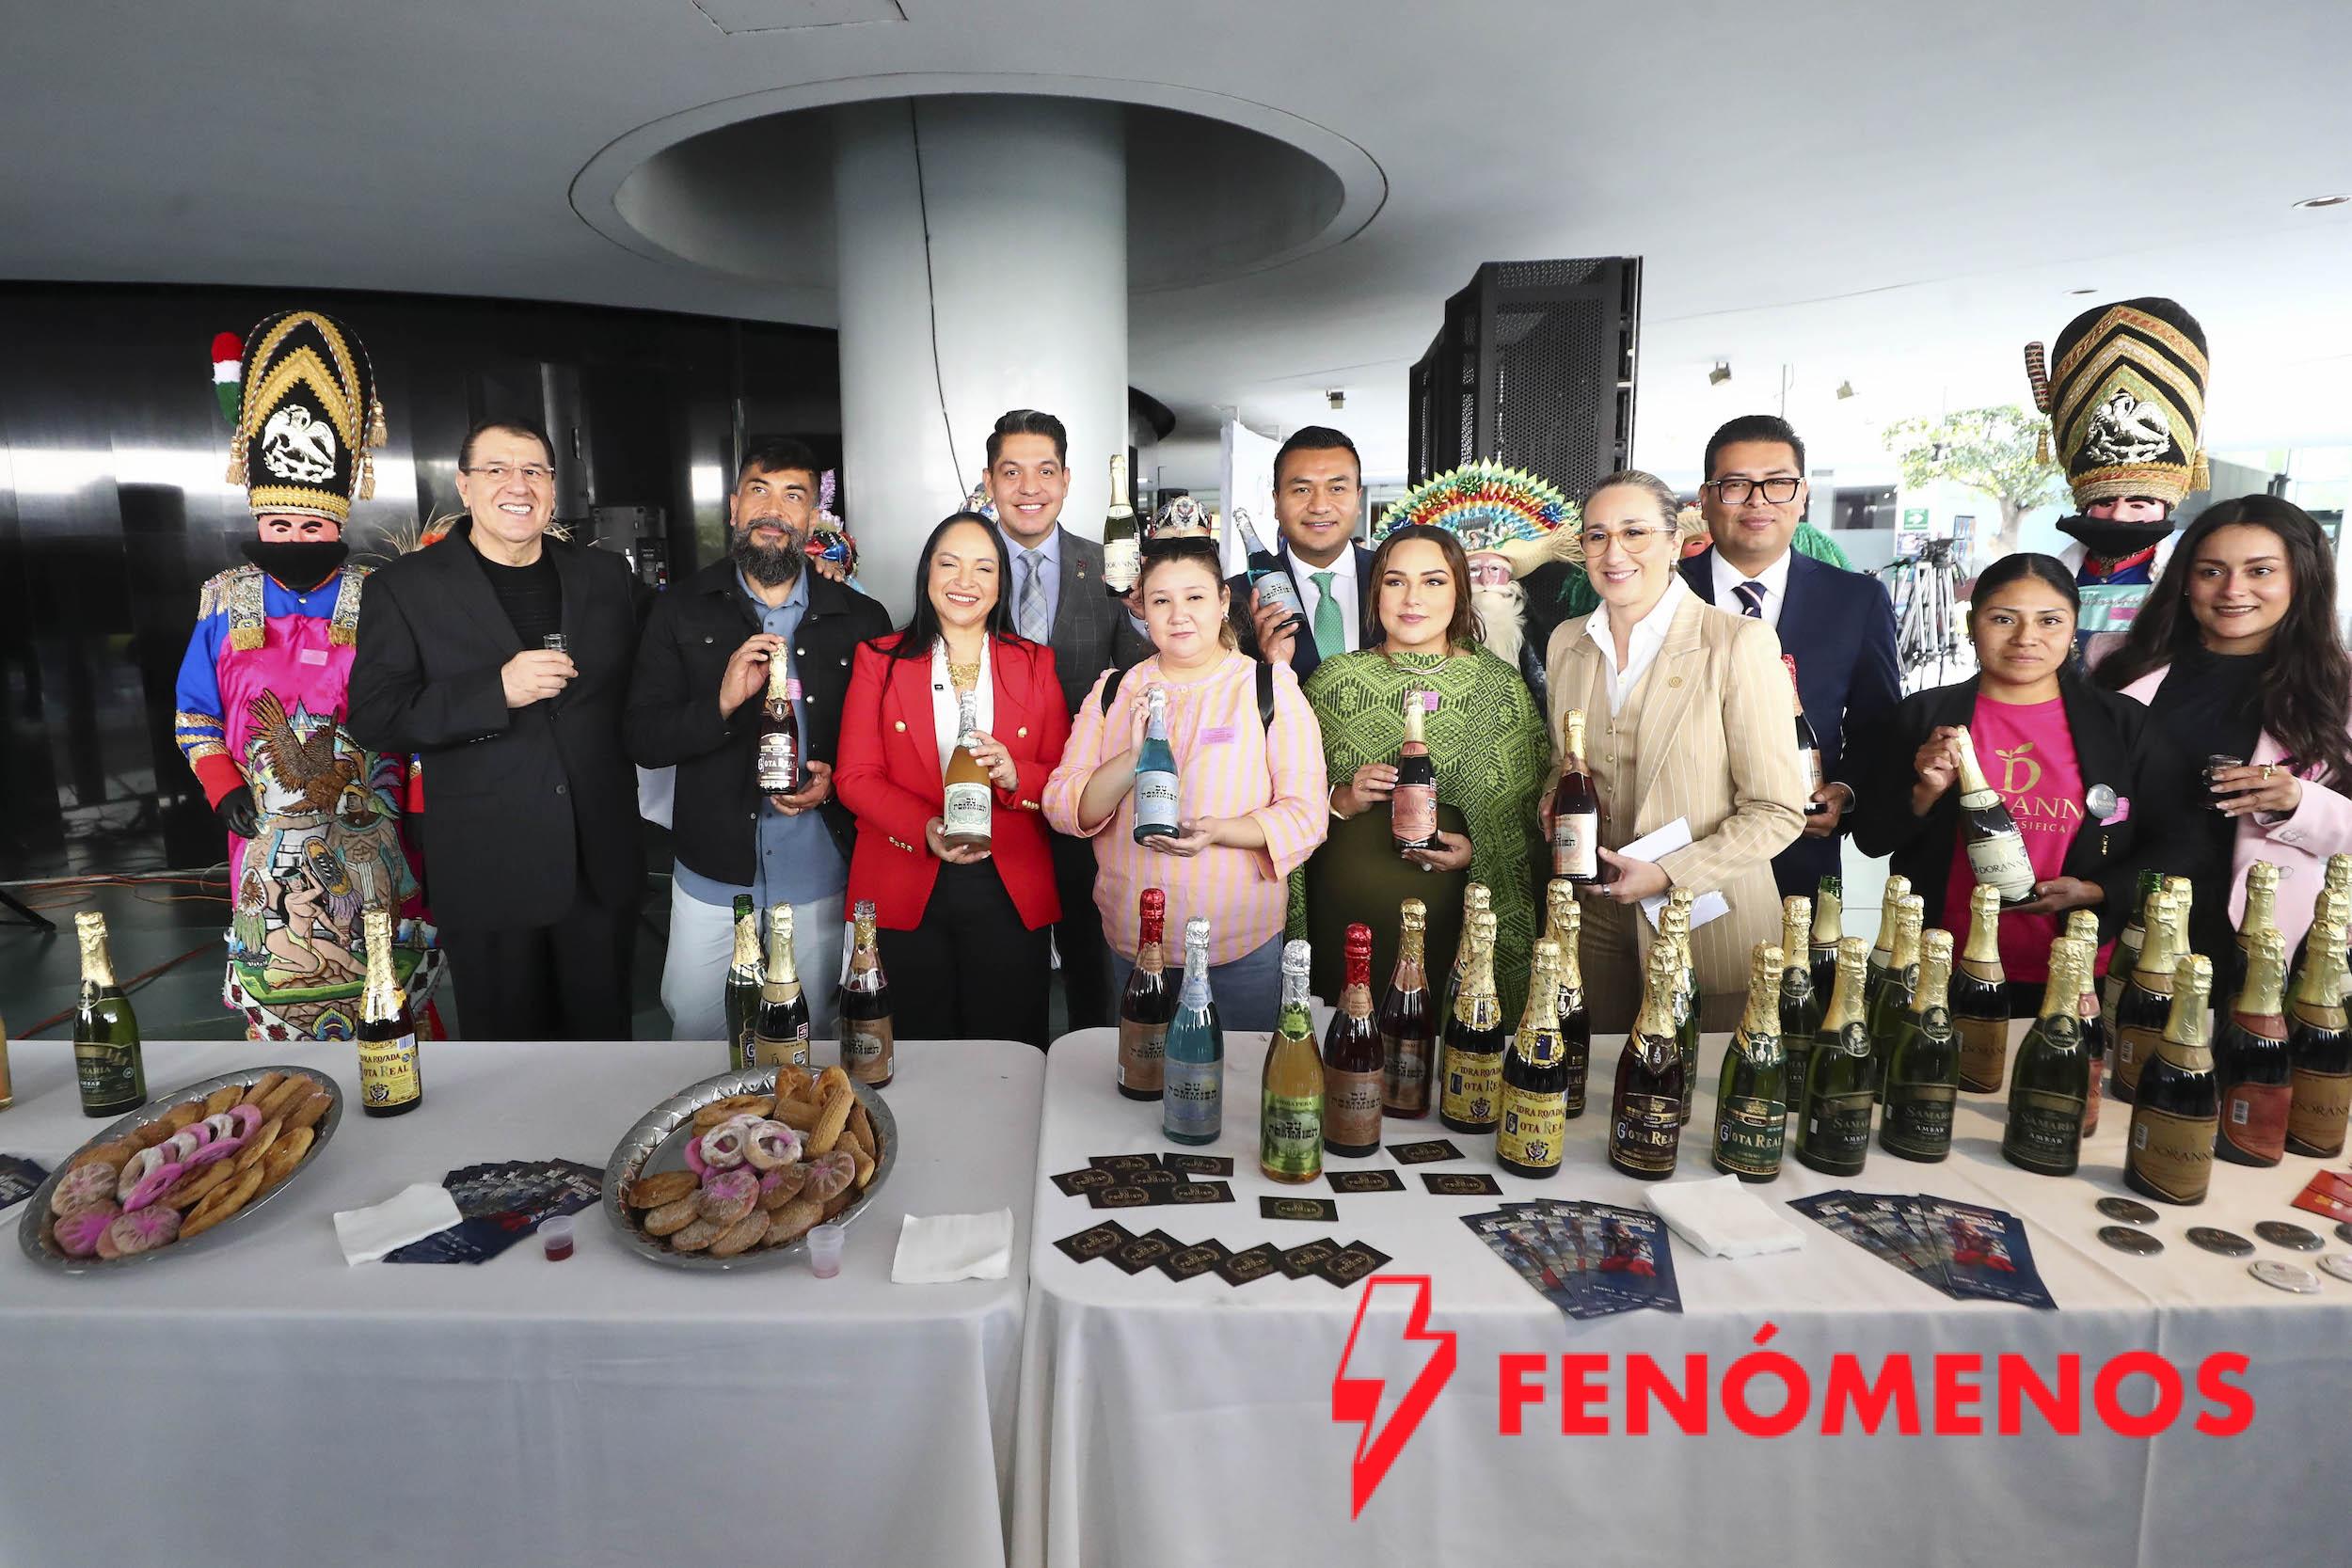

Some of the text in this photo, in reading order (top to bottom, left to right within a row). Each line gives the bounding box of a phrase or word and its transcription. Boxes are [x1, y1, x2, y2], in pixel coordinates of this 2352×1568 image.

[380, 1064, 408, 1077] REAL
[1168, 1085, 1217, 1101] POMMIER
[1184, 1082, 1200, 1092] DU
[1350, 1091, 1367, 1101] DU
[1720, 1124, 1783, 1148] GOTA REAL
